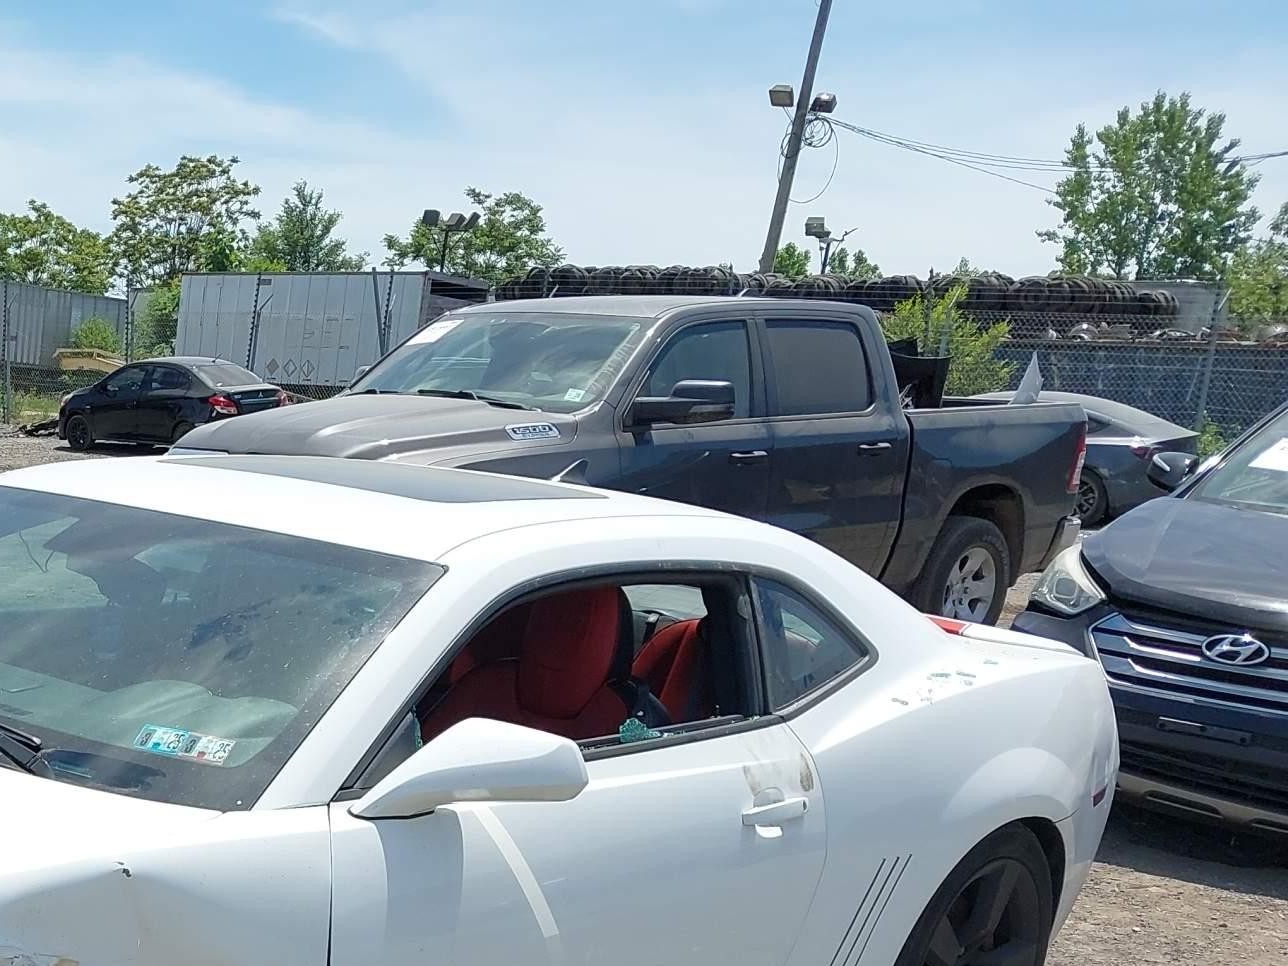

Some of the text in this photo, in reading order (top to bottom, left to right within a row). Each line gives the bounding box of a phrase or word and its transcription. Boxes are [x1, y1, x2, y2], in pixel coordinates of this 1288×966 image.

[513, 425, 550, 434] 1500
[140, 732, 186, 750] 3 25
[184, 738, 231, 759] 3 25
